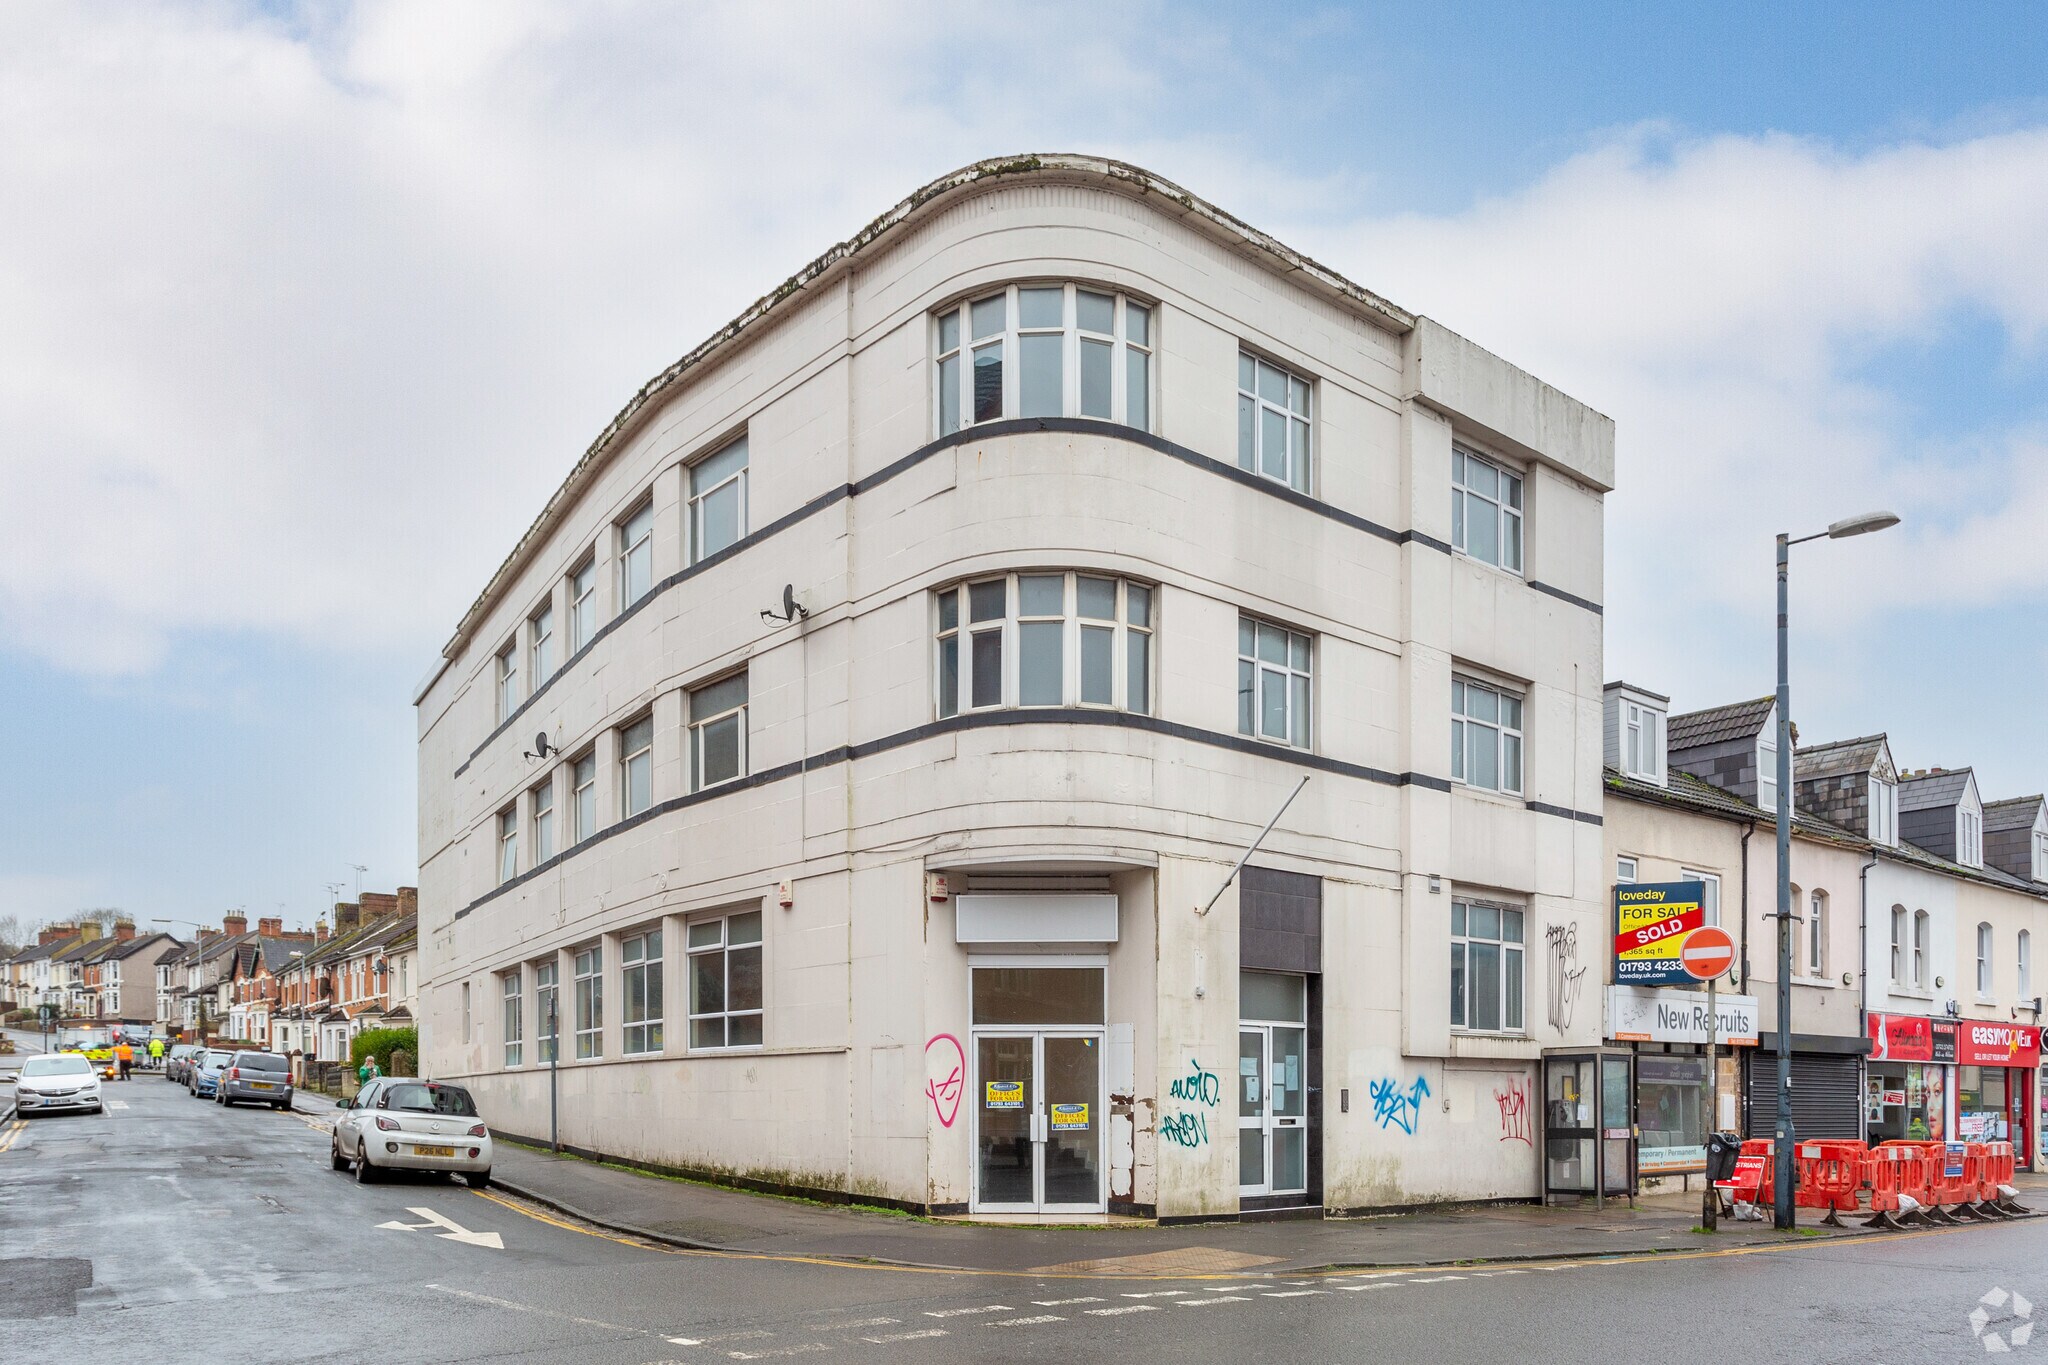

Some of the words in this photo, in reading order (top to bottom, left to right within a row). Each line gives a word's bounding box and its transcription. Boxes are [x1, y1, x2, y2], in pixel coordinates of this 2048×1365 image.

[1619, 889, 1666, 902] loveday
[1623, 908, 1652, 919] FOR
[1636, 919, 1683, 944] SOLD
[1645, 948, 1655, 956] sq
[1619, 961, 1652, 972] 01793
[1654, 960, 1684, 971] 4233
[1618, 972, 1666, 980] loveday.uk.com
[1658, 1003, 1690, 1030] New
[1693, 1006, 1749, 1033] Recruits
[1638, 1150, 1664, 1159] emporary
[1667, 1148, 1697, 1157] Permanent
